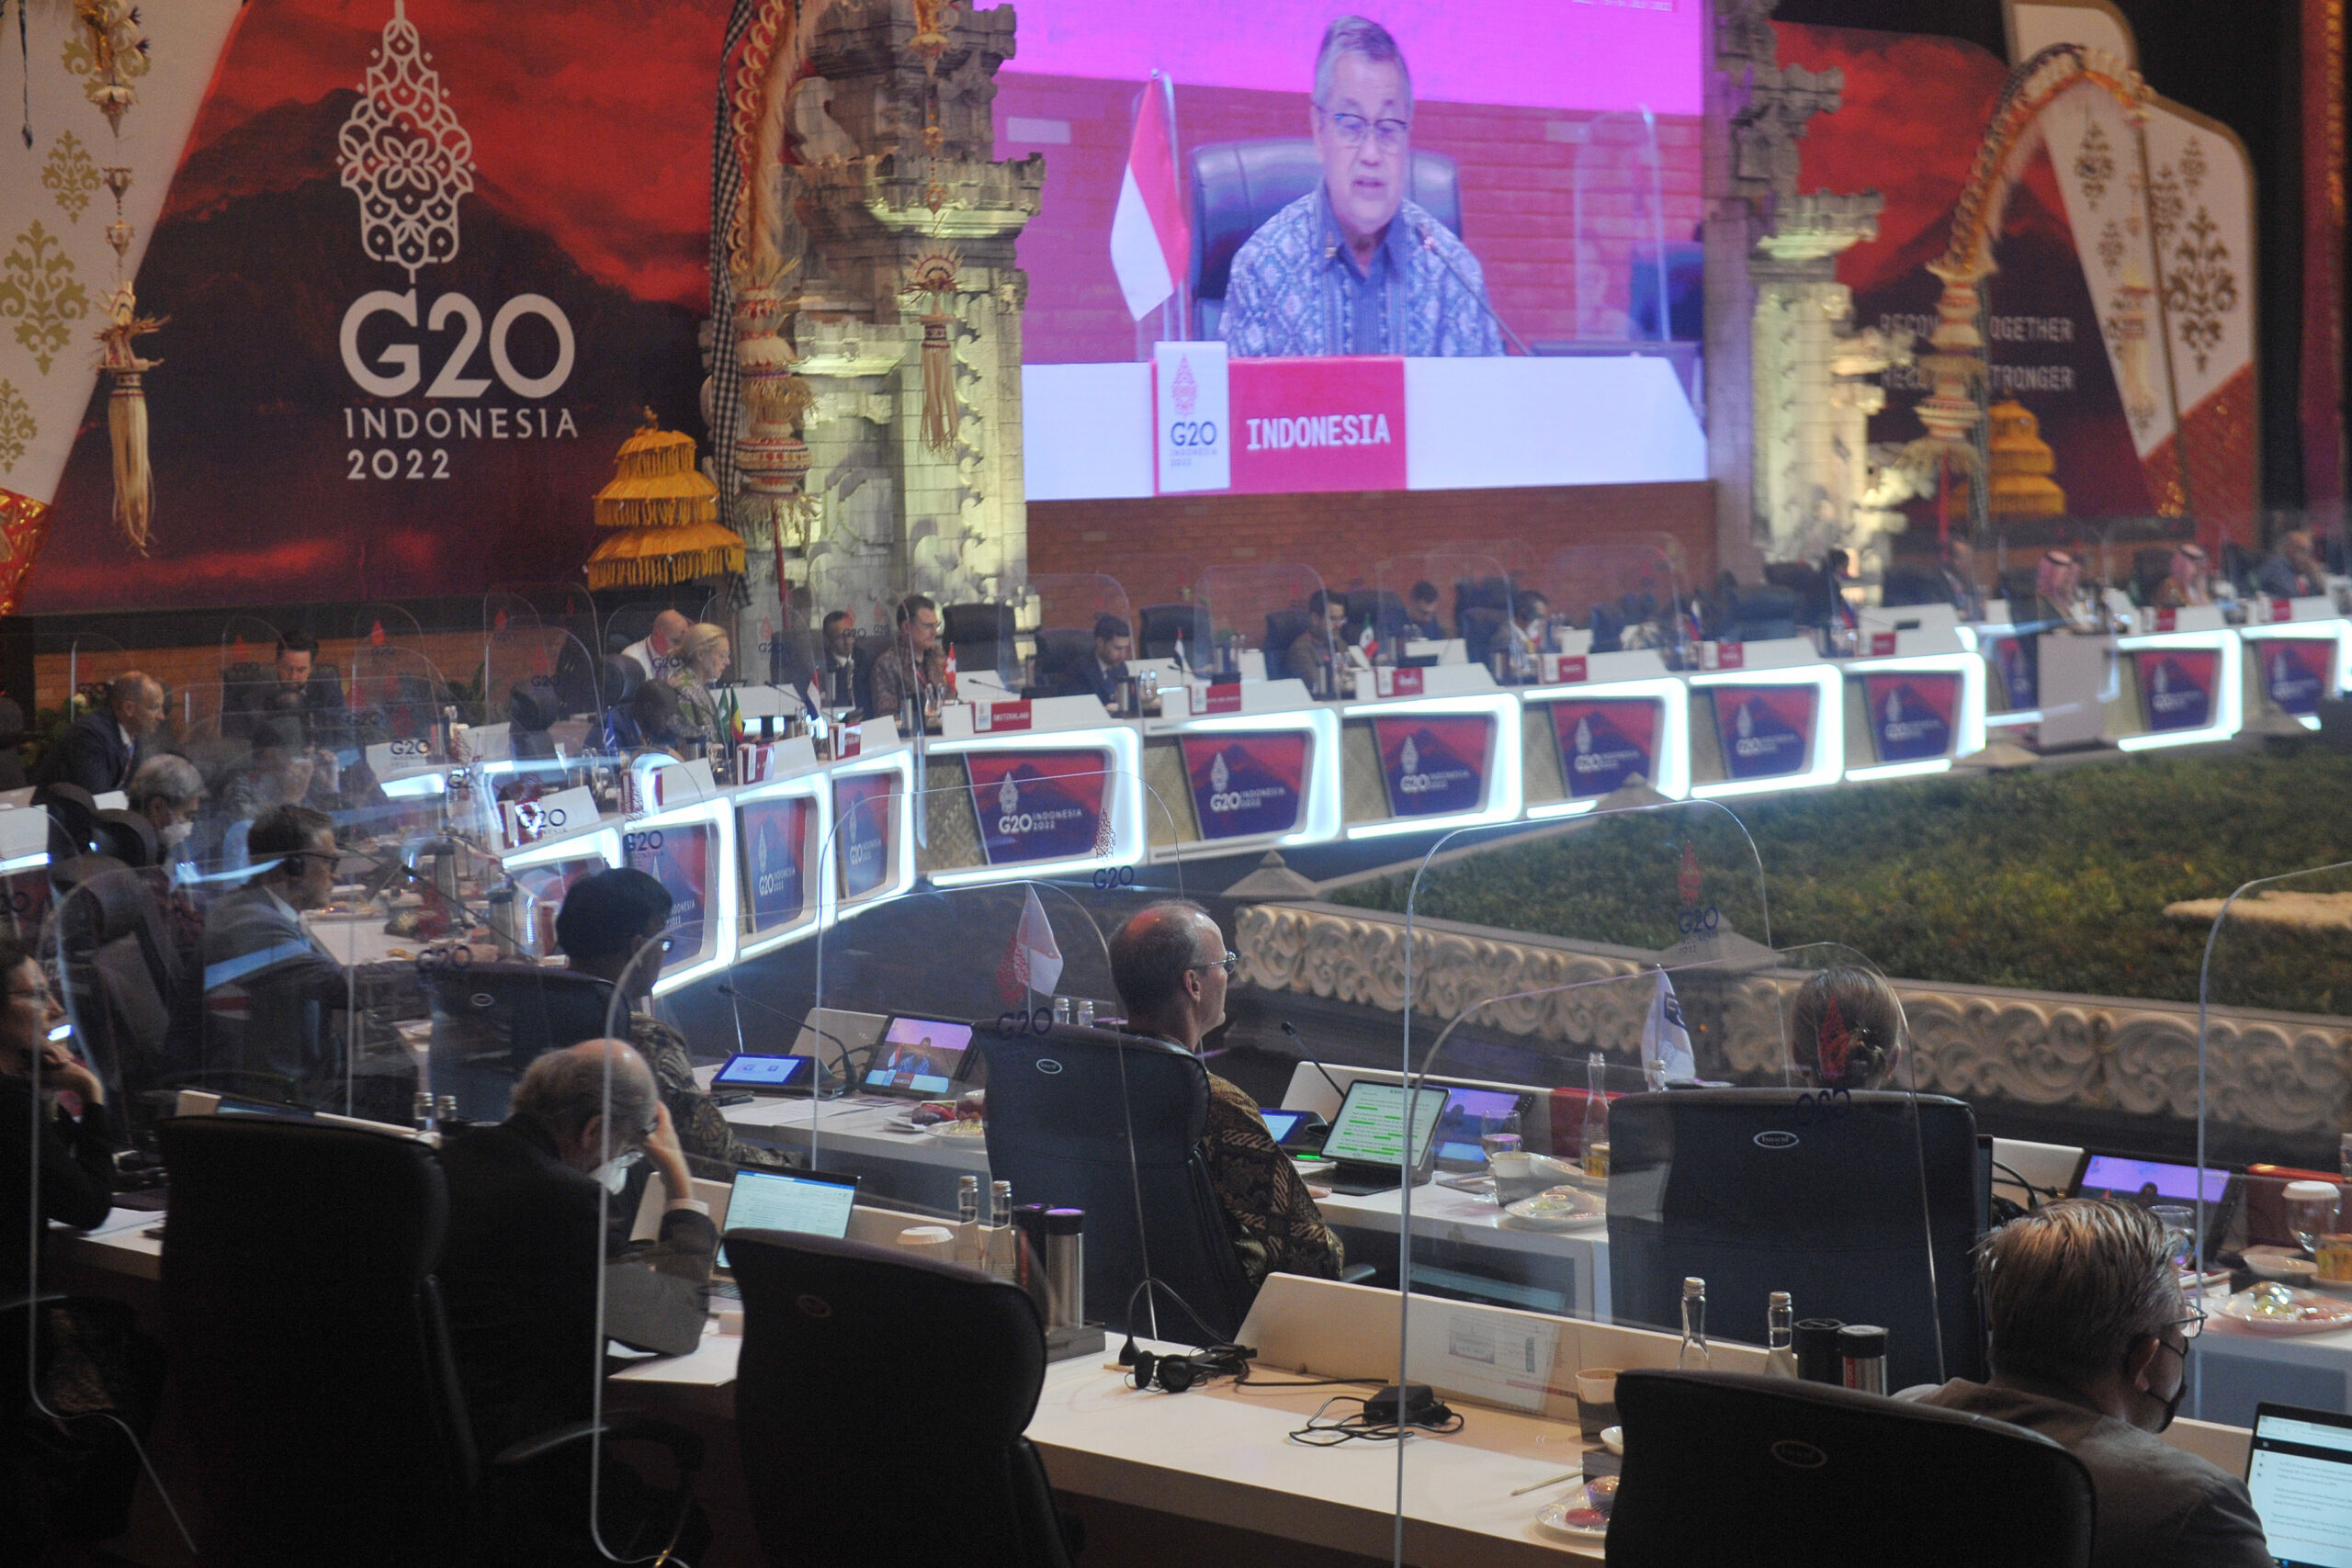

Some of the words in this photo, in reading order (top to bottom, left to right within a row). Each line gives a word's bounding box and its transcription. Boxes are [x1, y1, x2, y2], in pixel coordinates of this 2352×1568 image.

[1989, 315, 2075, 342] OGETHER
[340, 288, 575, 399] G20
[1990, 365, 2075, 390] TRONGER
[344, 408, 579, 439] INDONESIA
[1170, 421, 1217, 446] G20
[1246, 413, 1391, 450] INDONESIA
[346, 448, 450, 479] 2022
[390, 739, 431, 755] G20
[1210, 792, 1242, 813] G20
[999, 814, 1033, 835] G20
[1032, 808, 1082, 821] INDONESIA
[759, 874, 774, 897] G20
[1092, 865, 1134, 890] G20
[1678, 906, 1720, 935] G20
[997, 1007, 1053, 1041] G20
